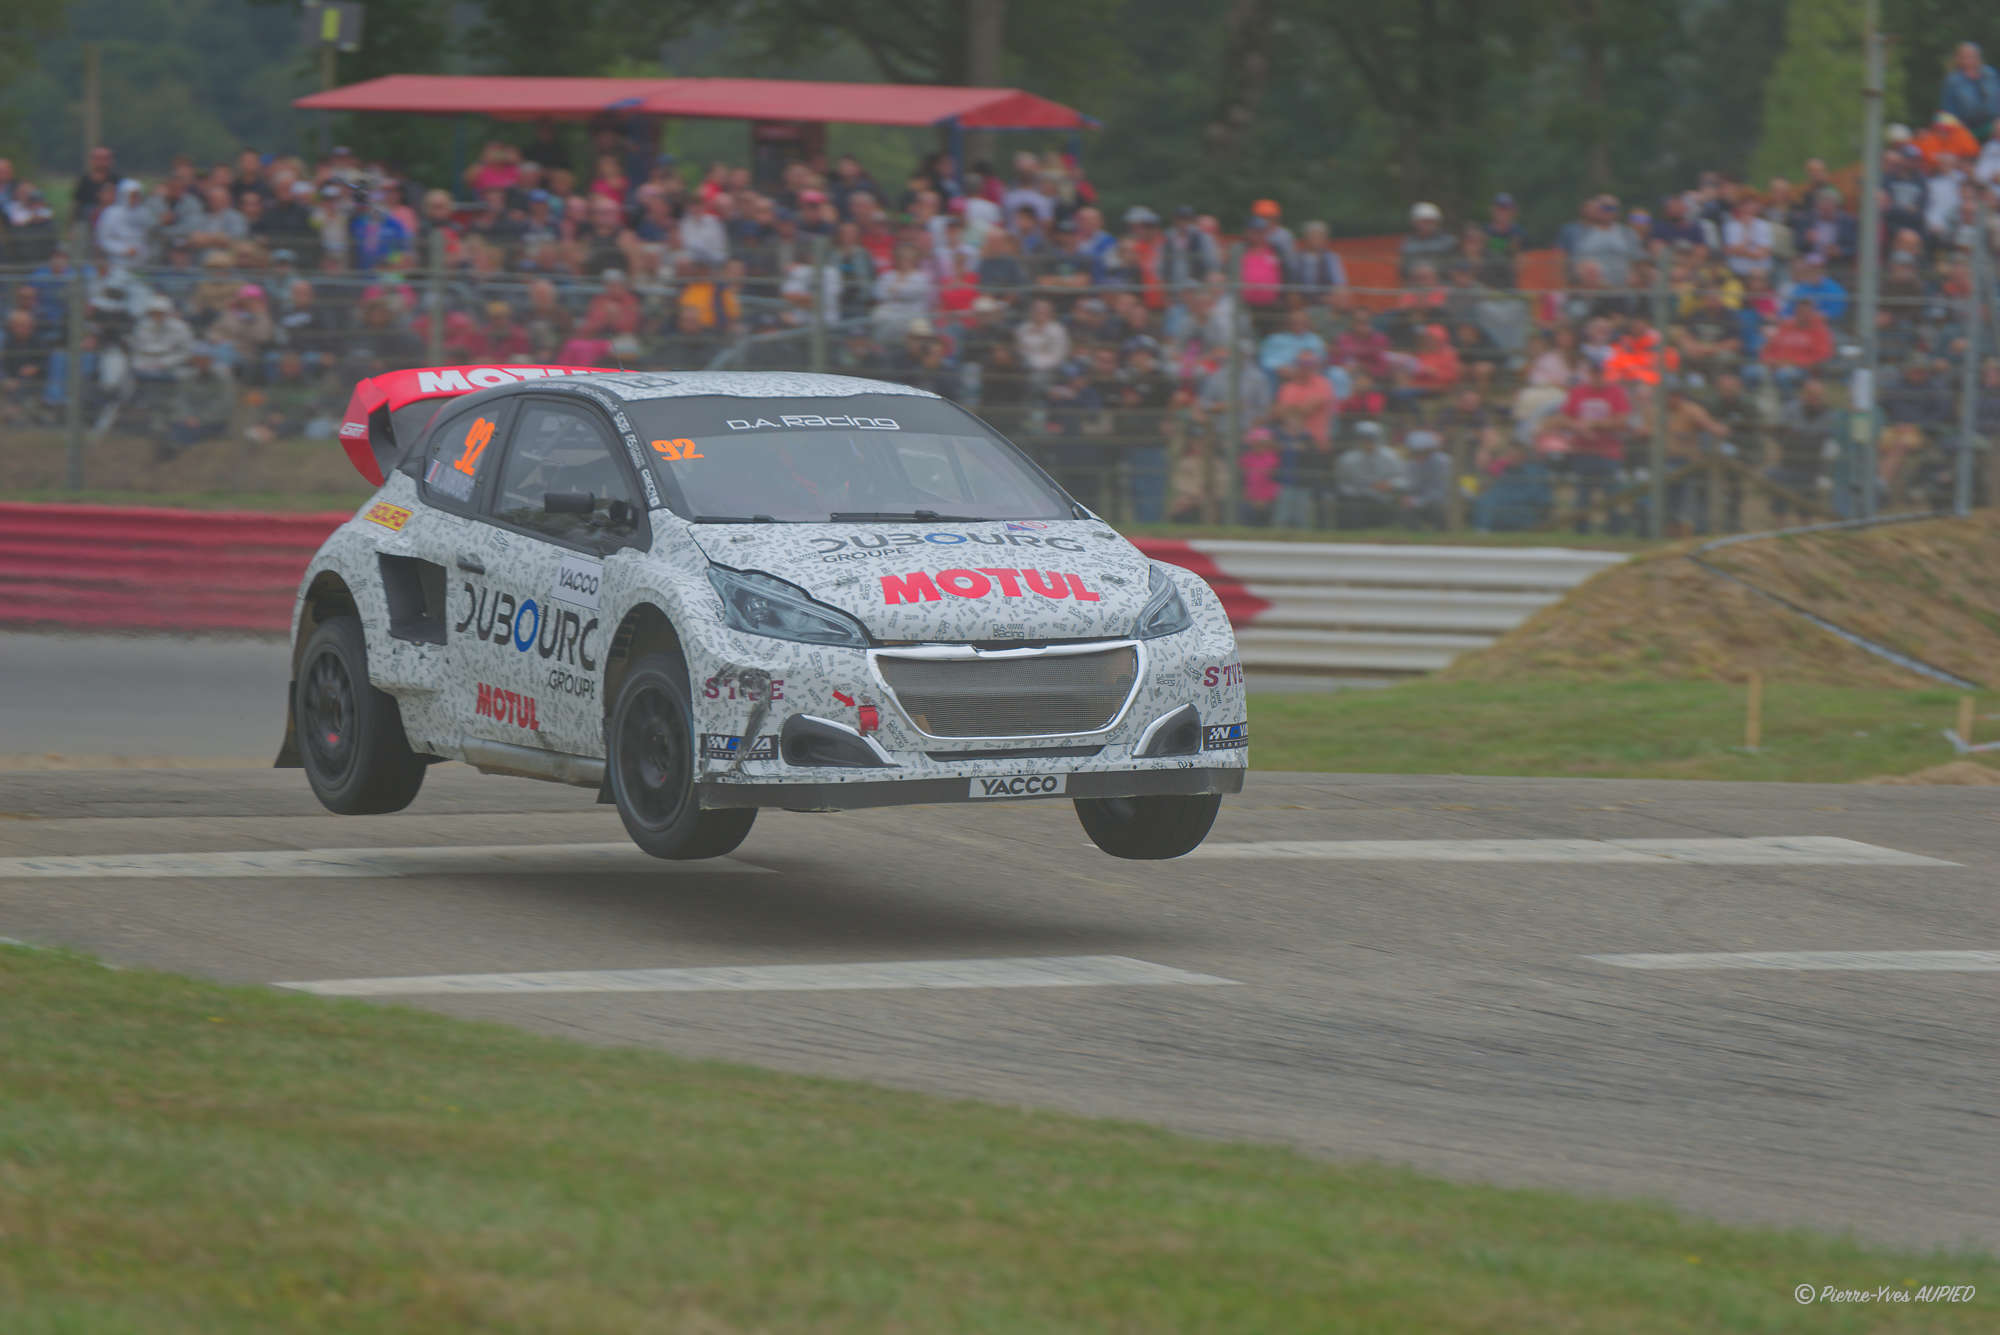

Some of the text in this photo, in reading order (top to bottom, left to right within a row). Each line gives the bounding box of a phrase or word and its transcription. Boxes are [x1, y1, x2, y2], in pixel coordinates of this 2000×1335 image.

[418, 368, 595, 393] MOT
[780, 415, 900, 430] Racing
[454, 417, 495, 476] 92
[651, 438, 704, 460] 92
[811, 532, 1085, 553] DUBOURG
[823, 548, 908, 563] GROUPE
[559, 566, 599, 596] YACCO
[880, 568, 1101, 604] MOTUL
[705, 676, 784, 701] STE
[476, 682, 540, 730] MOTUL
[980, 775, 1058, 796] YACCO
